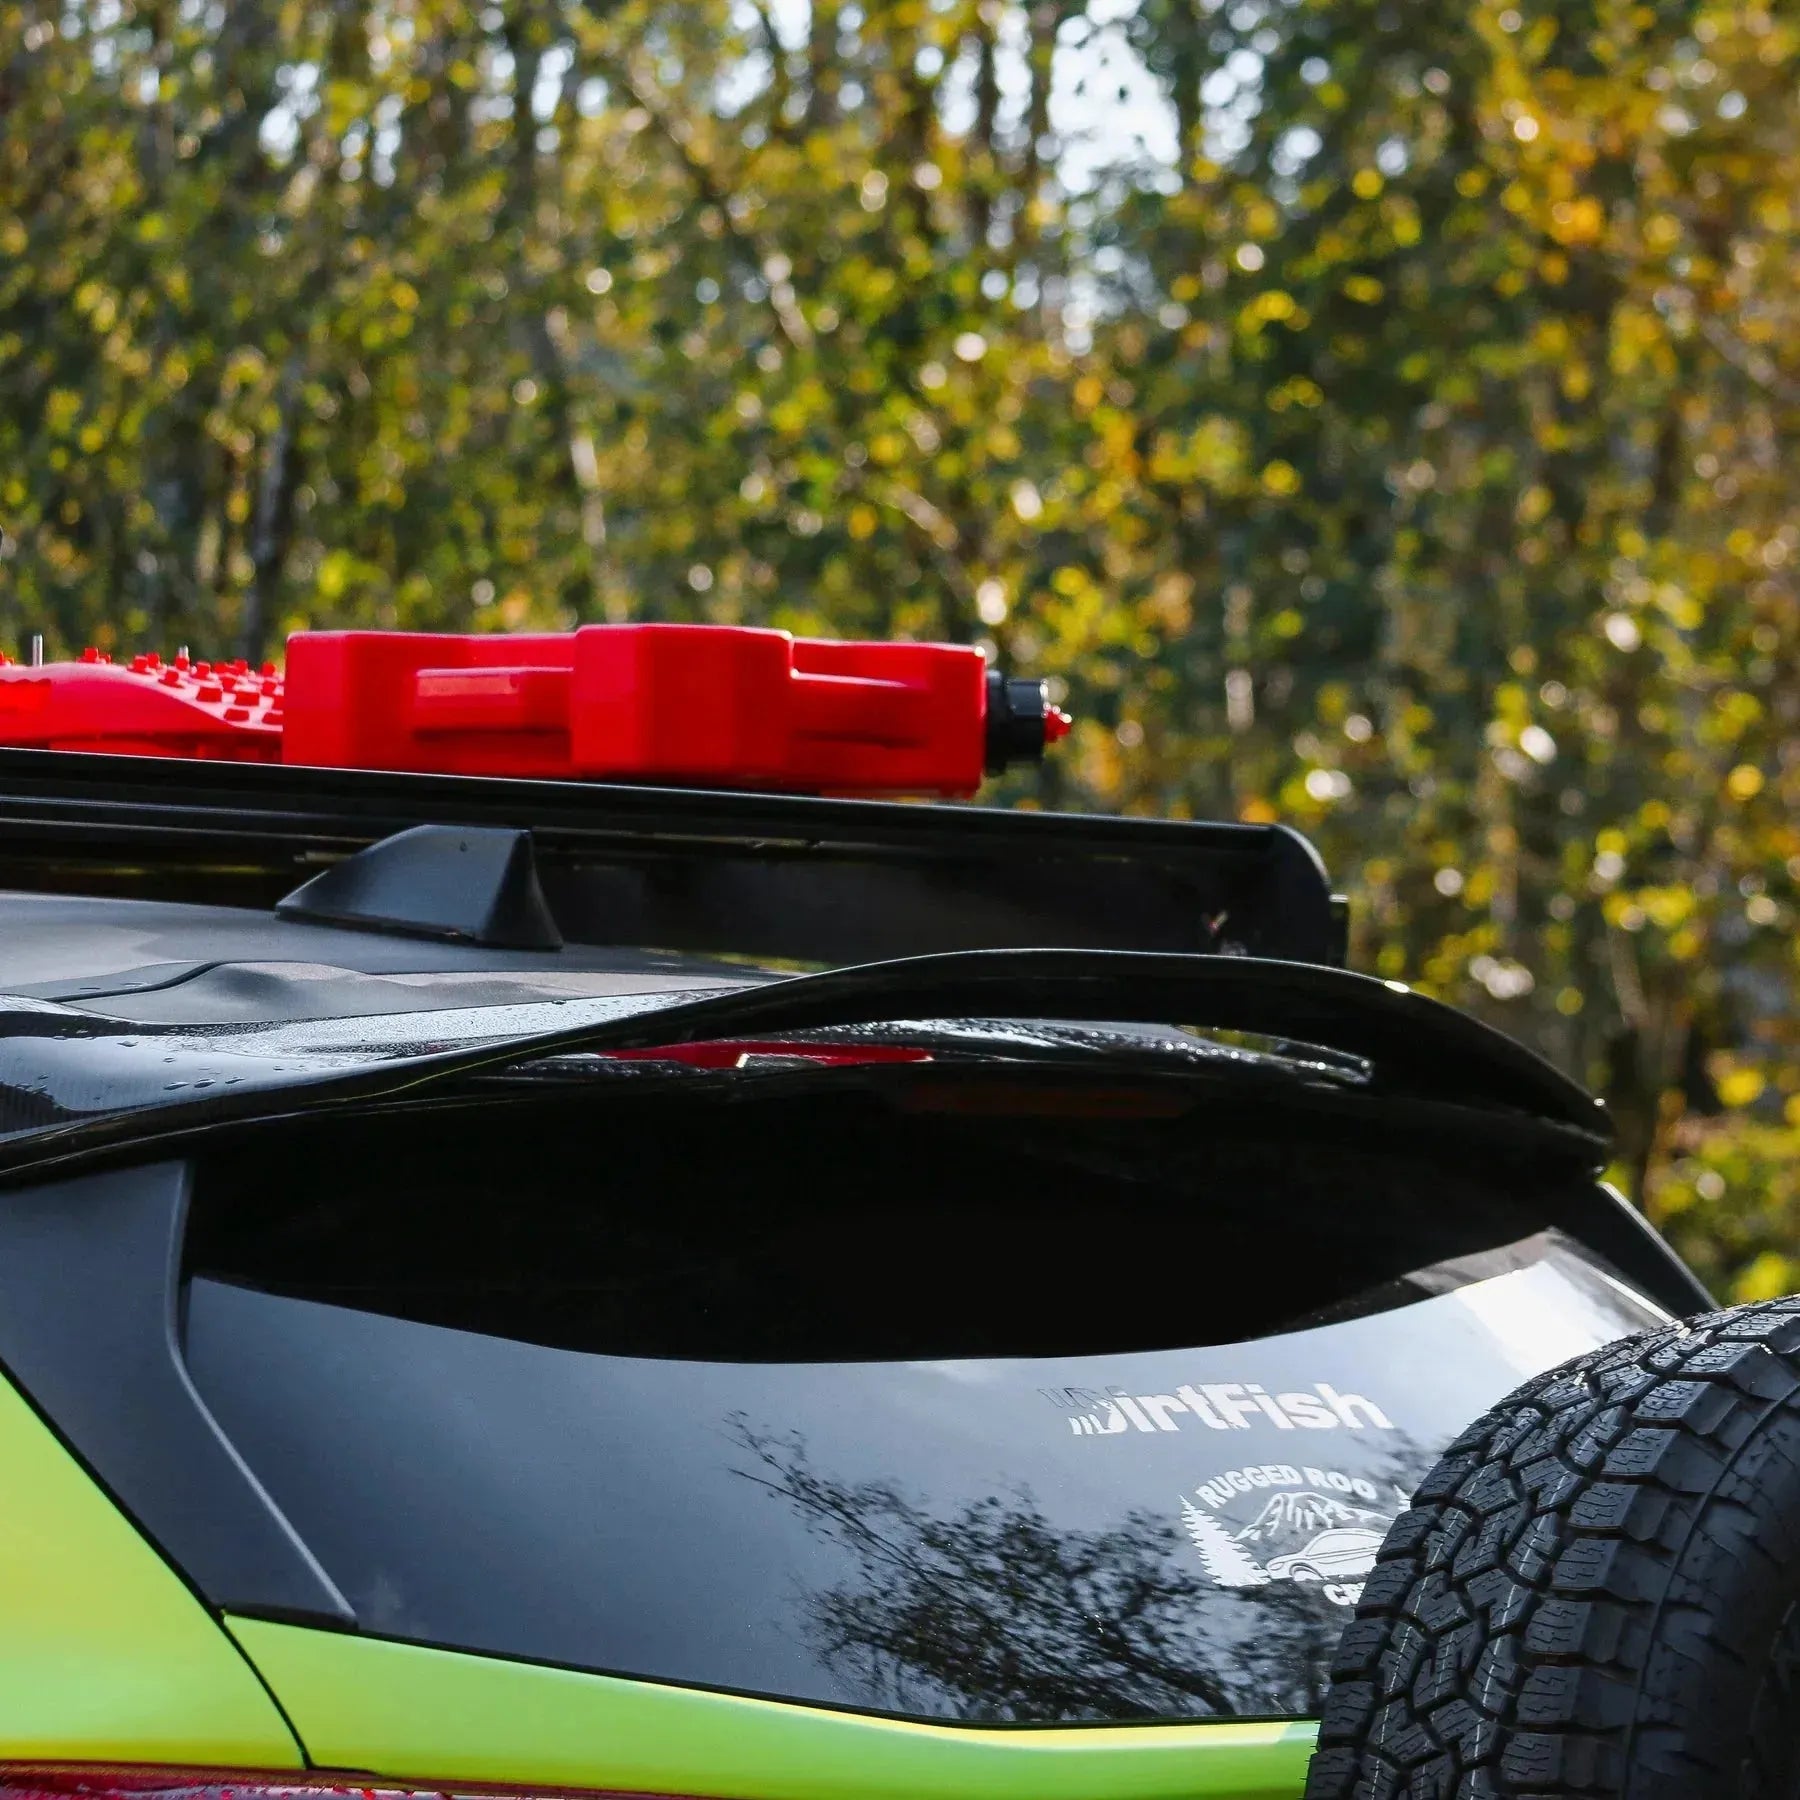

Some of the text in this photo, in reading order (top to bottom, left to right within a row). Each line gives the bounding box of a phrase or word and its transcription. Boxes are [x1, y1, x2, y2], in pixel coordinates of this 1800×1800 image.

[1062, 1382, 1394, 1435] DirtFish
[1196, 1464, 1378, 1508] RUGGED ROO
